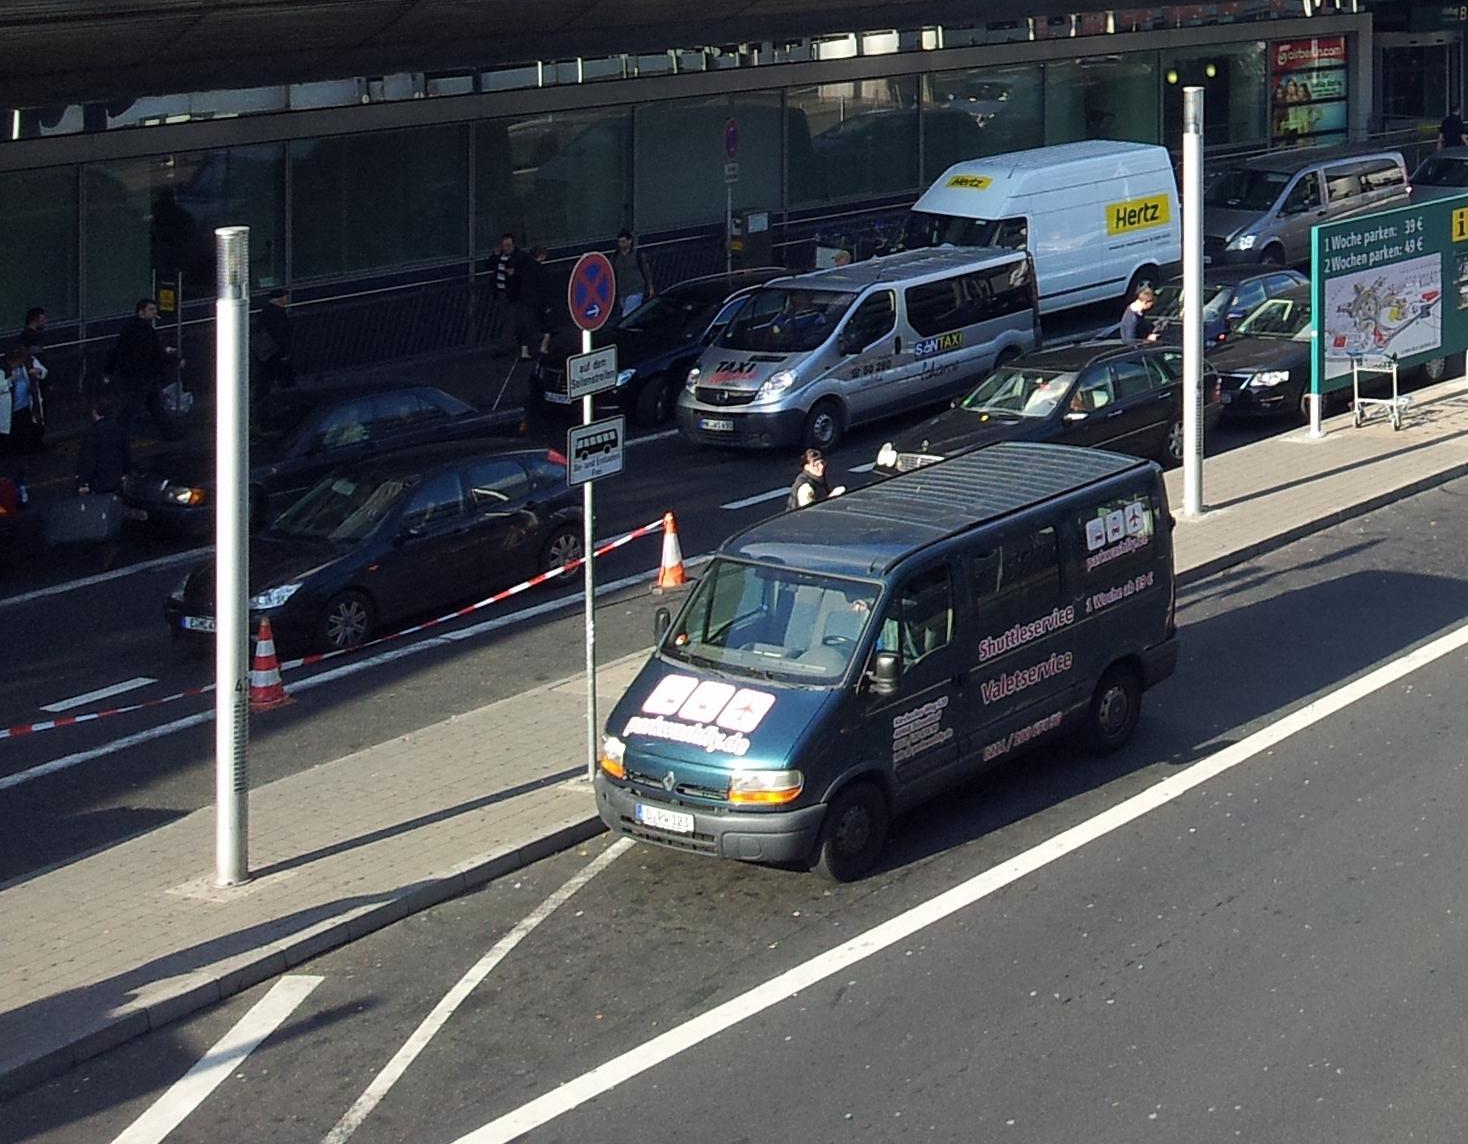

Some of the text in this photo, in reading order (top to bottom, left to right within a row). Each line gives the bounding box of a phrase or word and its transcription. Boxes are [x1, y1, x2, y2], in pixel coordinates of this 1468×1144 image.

[1459, 6, 1467, 21] B
[952, 175, 983, 188] Hertz
[1115, 202, 1160, 229] Hertz
[1325, 216, 1423, 252] 1 Woche parken: 39 €
[1324, 236, 1423, 273] 2 Wochen parken: 49 €
[715, 360, 757, 373] TAXI
[1093, 587, 1123, 610] Woche
[1123, 579, 1135, 597] ab
[979, 605, 1074, 661] Shuttleservice
[980, 652, 1073, 704] Valetservice
